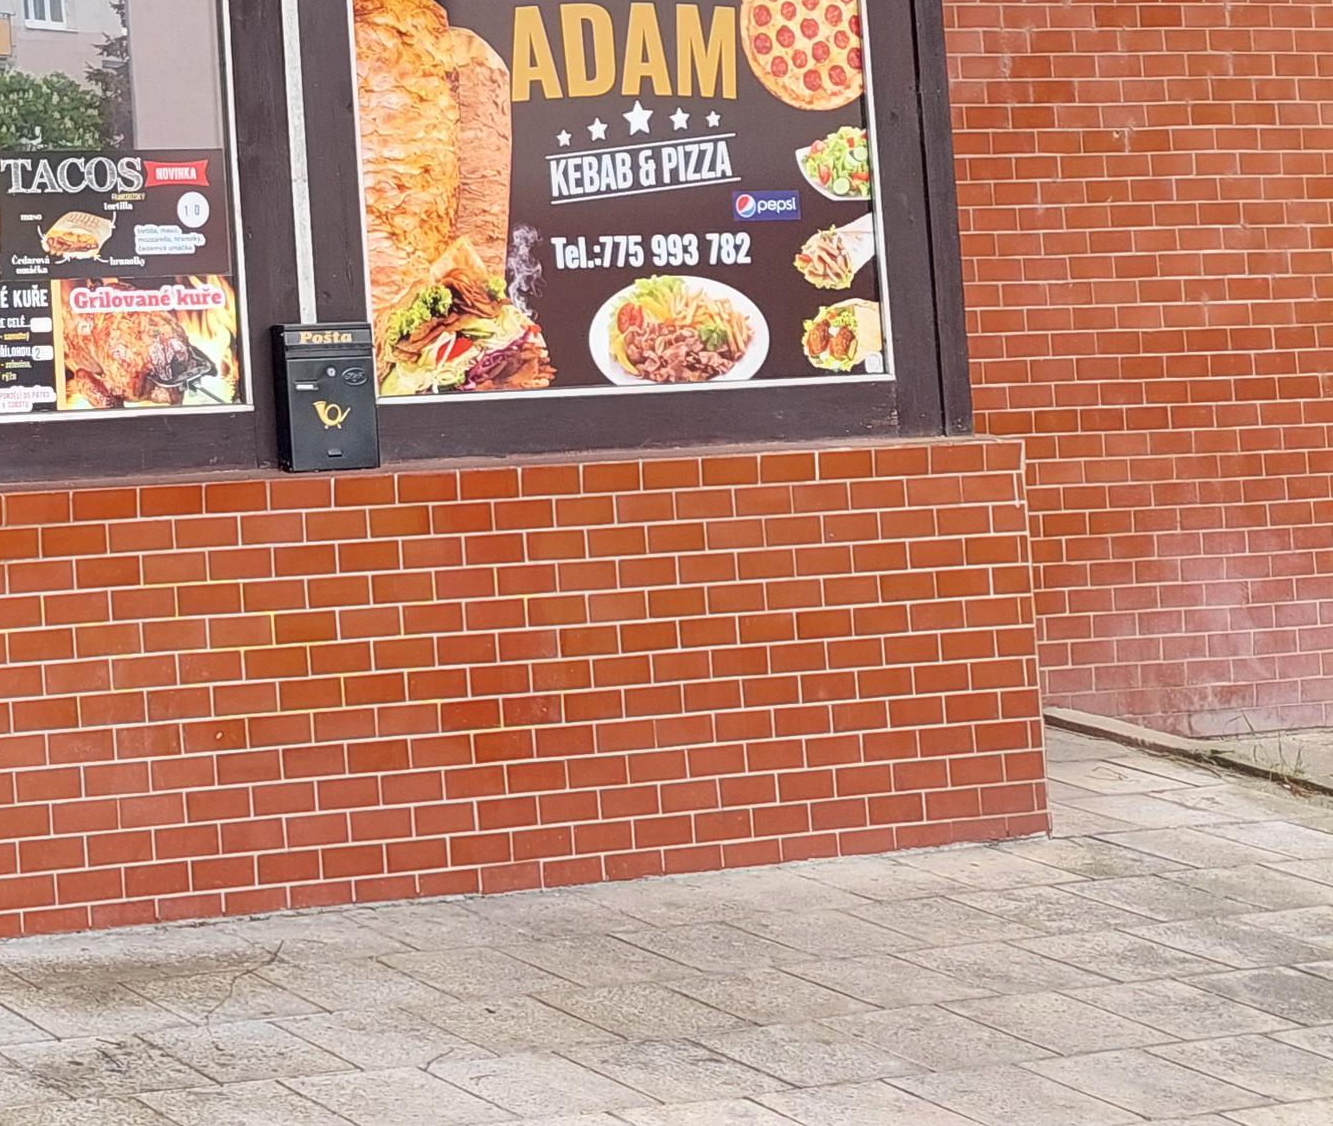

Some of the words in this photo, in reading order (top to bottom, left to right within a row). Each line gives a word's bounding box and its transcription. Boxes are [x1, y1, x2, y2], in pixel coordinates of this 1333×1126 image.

[511, 2, 737, 102] ADAM
[0, 157, 144, 194] TACOS
[156, 167, 197, 180] NOVINKA
[549, 151, 633, 198] KEBAB
[639, 149, 657, 187] &
[661, 140, 733, 184] PIZZA
[757, 197, 796, 214] pepsi
[651, 234, 700, 266] 993
[705, 232, 751, 265] 782
[13, 285, 48, 307] KUŘE
[74, 288, 171, 309] Grilované
[176, 286, 222, 305] kuře
[299, 331, 353, 344] Pošta
